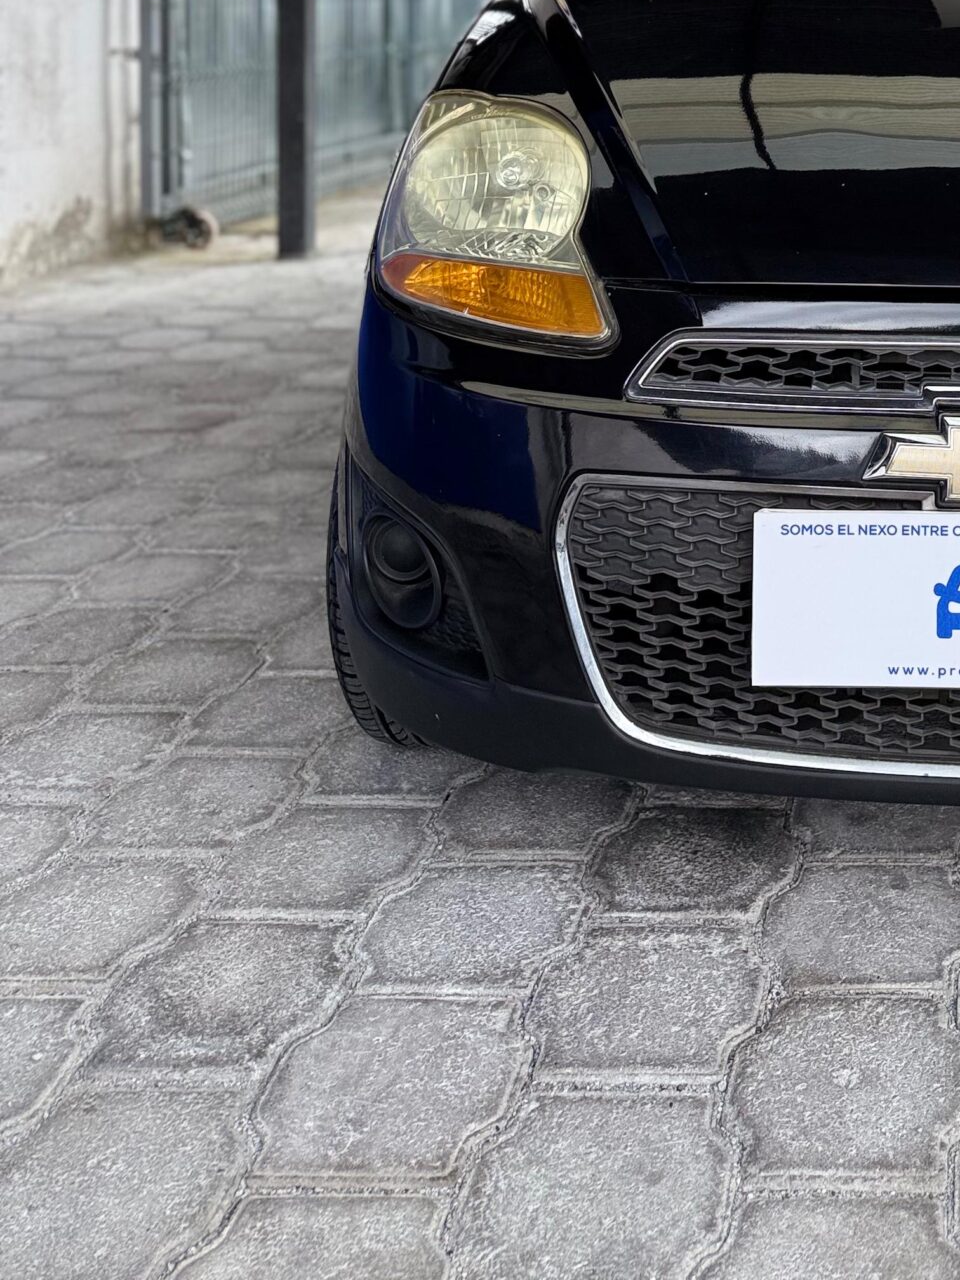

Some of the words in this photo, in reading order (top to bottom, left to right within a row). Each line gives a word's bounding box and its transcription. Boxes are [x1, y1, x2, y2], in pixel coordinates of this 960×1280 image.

[780, 524, 834, 536] SOMOS
[837, 524, 855, 536] EL
[858, 524, 898, 536] NEXO
[901, 524, 949, 537] ENTRE
